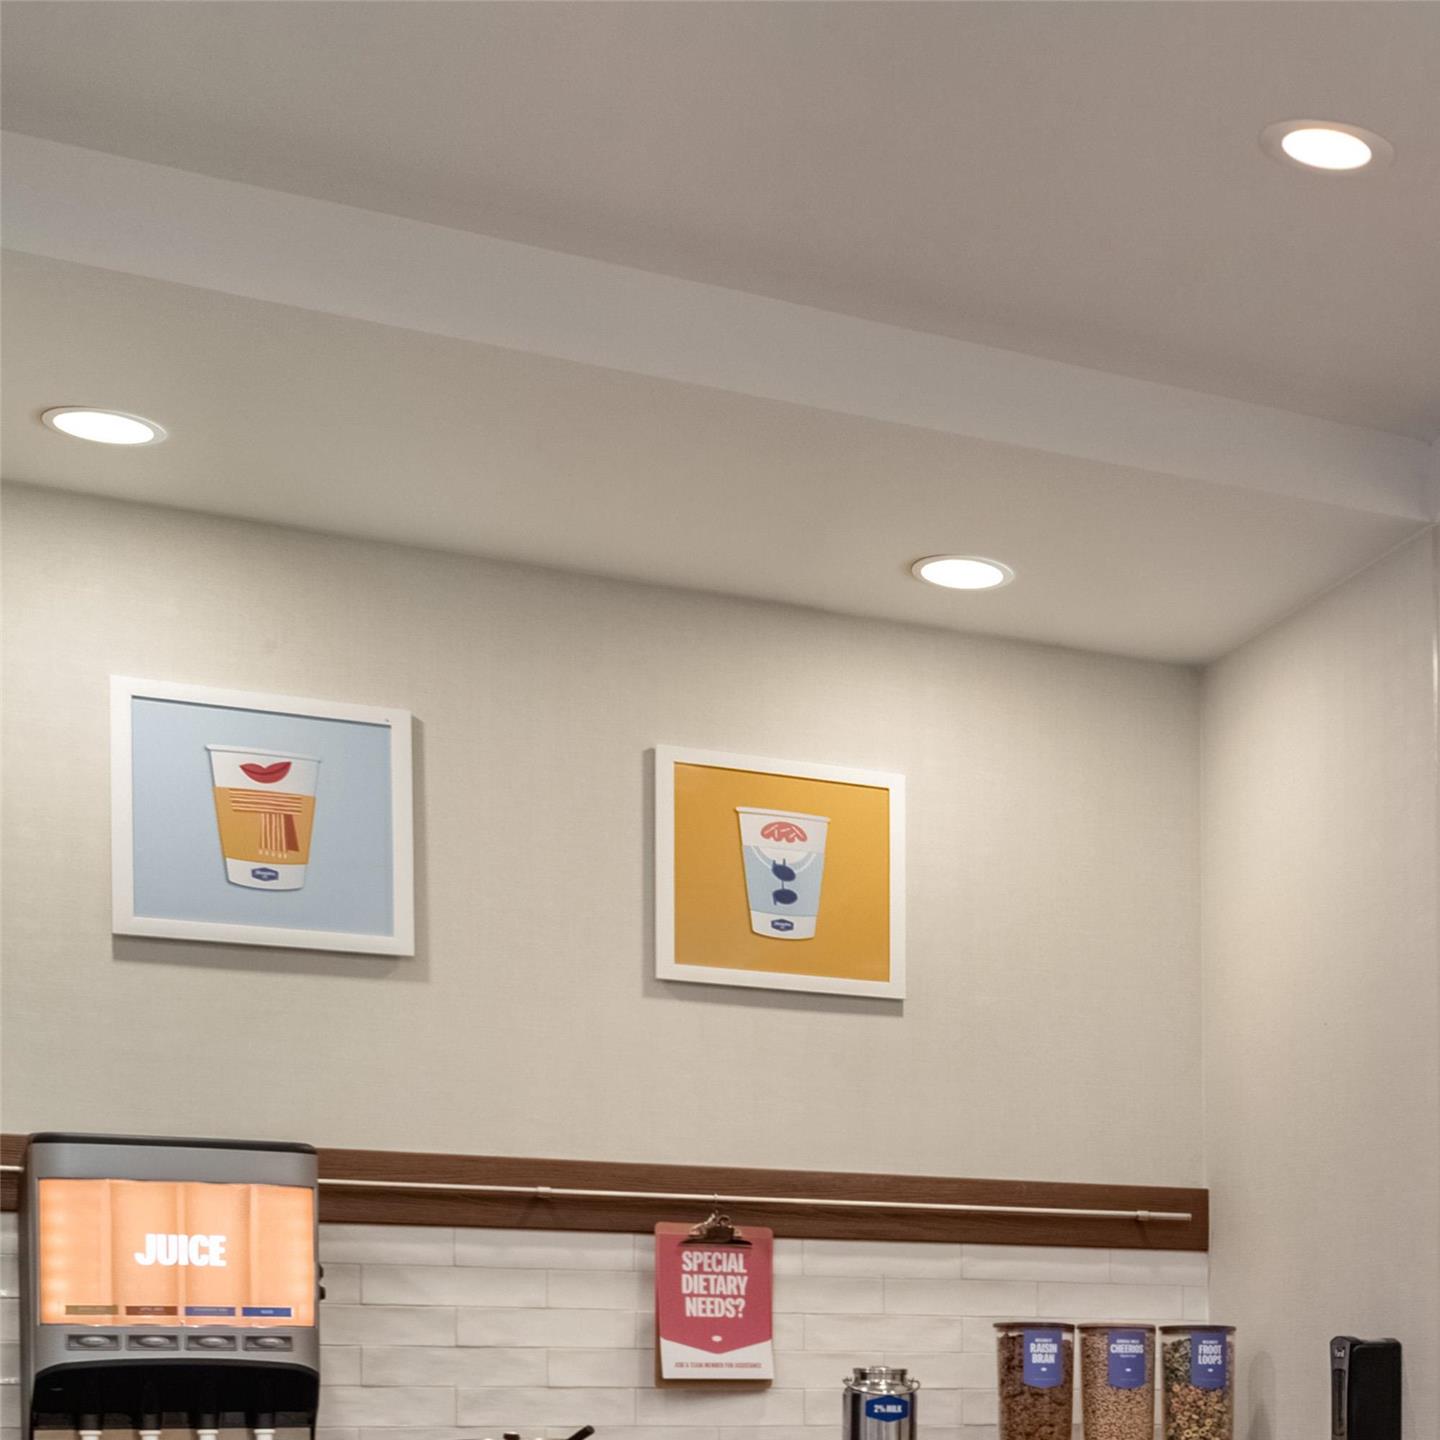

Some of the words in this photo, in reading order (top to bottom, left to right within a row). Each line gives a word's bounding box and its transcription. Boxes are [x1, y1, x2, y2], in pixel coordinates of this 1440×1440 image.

[134, 1233, 227, 1267] JUICE
[681, 1250, 748, 1273] SPECIAL
[681, 1273, 749, 1296] DIETARY
[685, 1296, 746, 1318] NEEDS?
[1030, 1342, 1058, 1353] RAISIN
[1110, 1343, 1144, 1354] CHEERIOS
[1198, 1344, 1222, 1355] FROOT
[1031, 1353, 1056, 1364] BRAN
[1198, 1354, 1222, 1365] LOOPS
